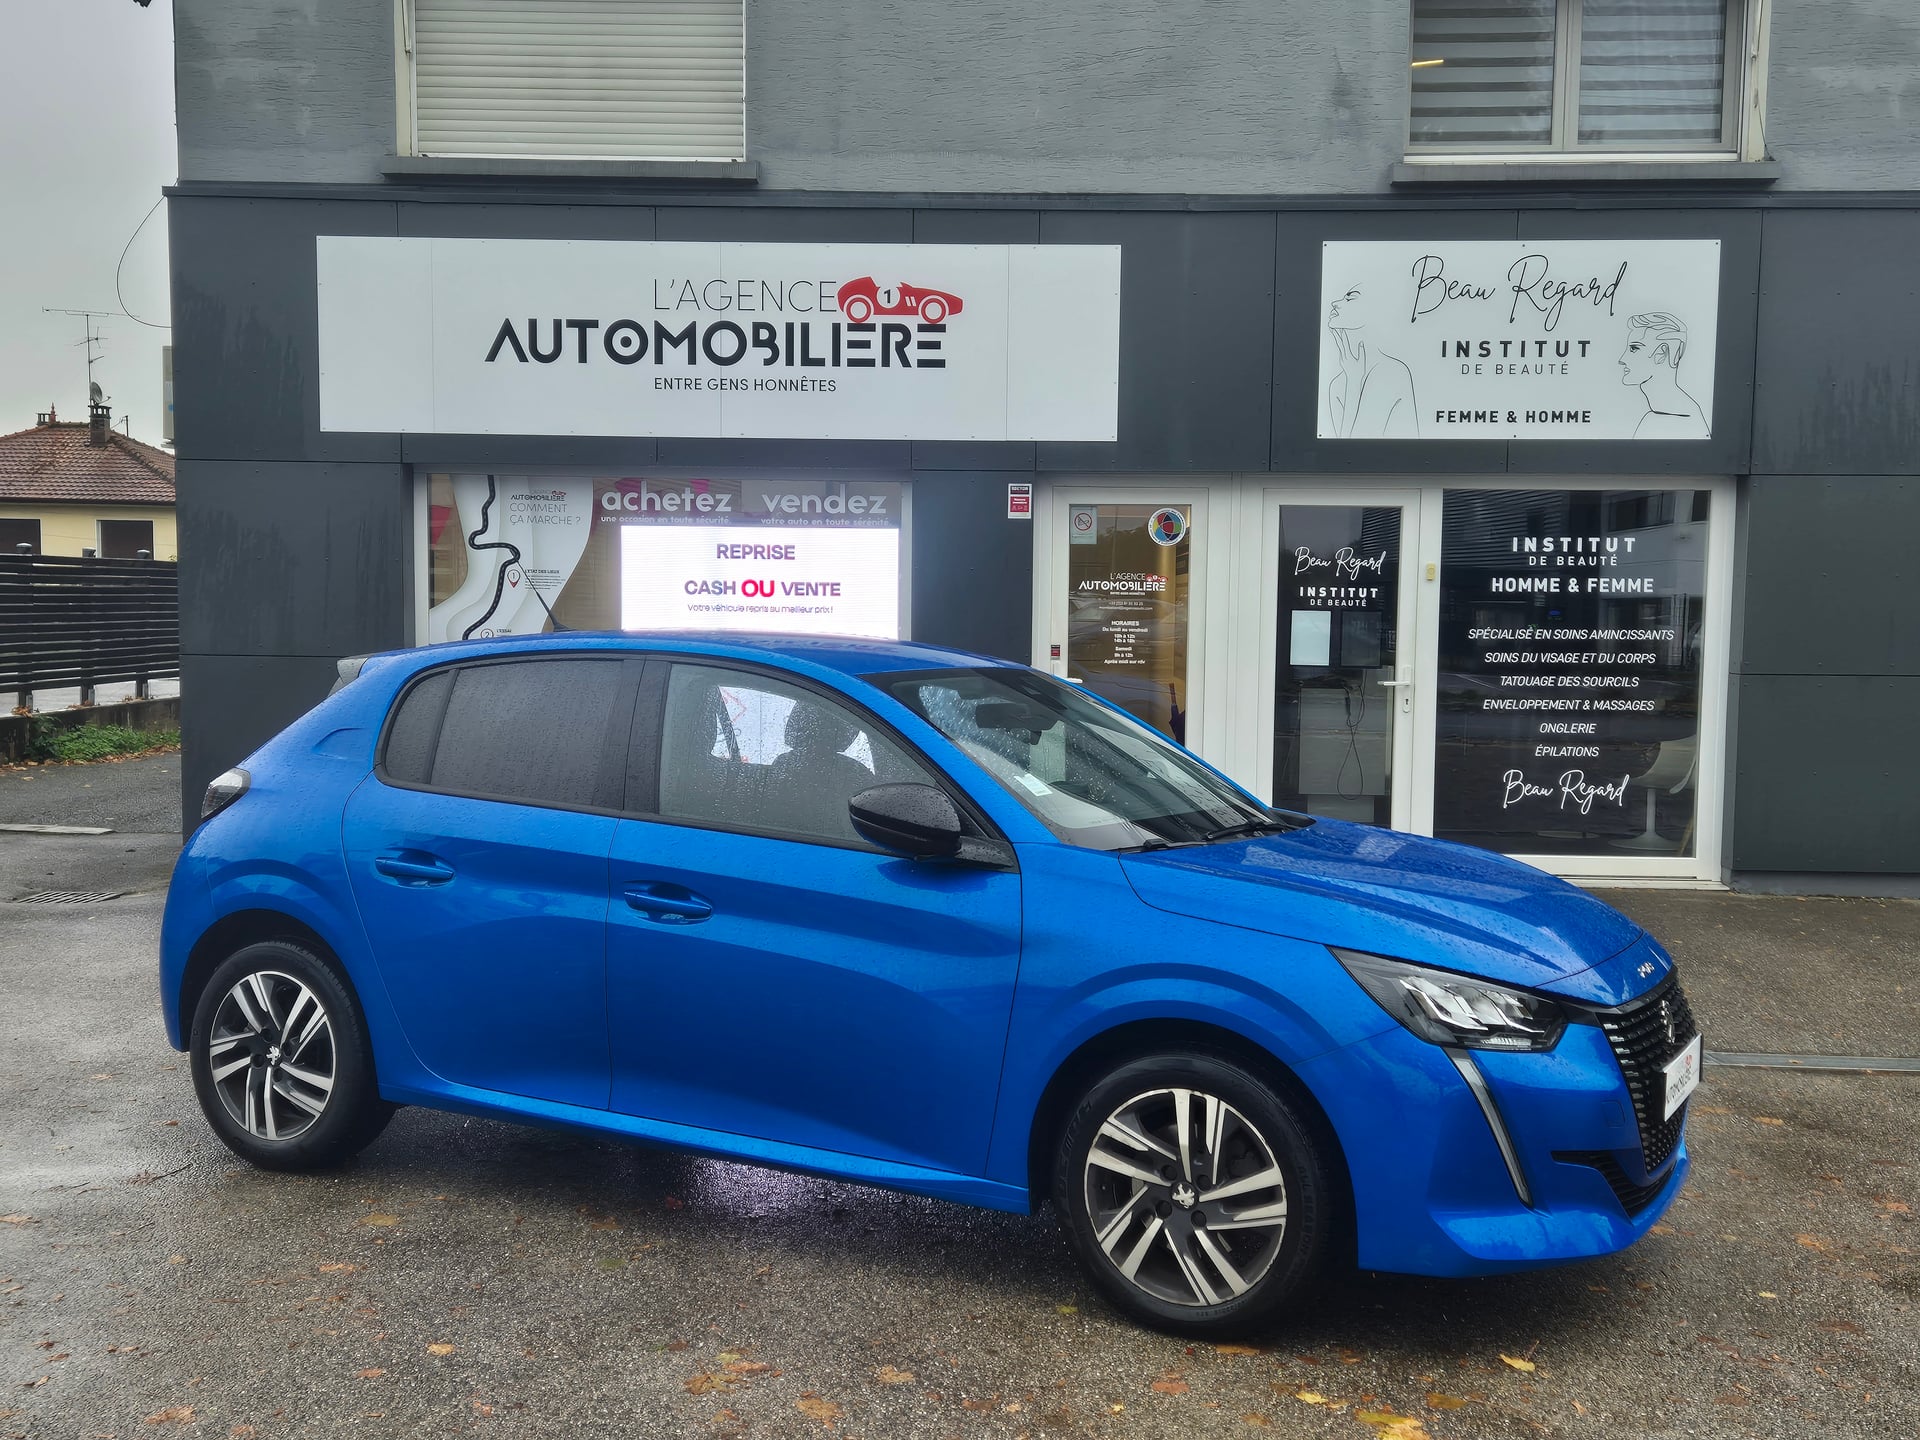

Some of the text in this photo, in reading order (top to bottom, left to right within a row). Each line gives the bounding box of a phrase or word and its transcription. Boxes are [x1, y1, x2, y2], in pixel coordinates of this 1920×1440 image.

[653, 279, 837, 312] L'AGENCE
[1411, 254, 1628, 332] Beau Regard
[1441, 340, 1593, 358] INSTITUT
[1461, 361, 1570, 376] DE BEAUTÉ
[654, 375, 837, 393] ENTRE GENS HONNÊTES
[1436, 411, 1593, 423] FEMME & HOMME
[601, 480, 732, 512] achetez
[762, 483, 887, 514] vendez
[509, 503, 568, 513] COMMENT
[509, 514, 581, 526] ÇA MARCHE ?
[618, 514, 656, 523] occasion
[670, 515, 694, 524] toute
[760, 518, 785, 526] votre
[787, 518, 809, 526] auto
[811, 518, 823, 526] en
[825, 518, 850, 526] toute
[1512, 537, 1636, 552] INSTITUT
[716, 544, 796, 560] REPRISE
[1294, 546, 1387, 581] Beau Regard
[1528, 554, 1618, 567] DE BEAUTÉ
[684, 579, 841, 597] CASH OU VENTE
[1300, 586, 1379, 598] INSTITUT
[1491, 578, 1655, 593] HOMME & FEMME
[687, 604, 711, 613] Votre
[711, 604, 745, 613] véhicule
[745, 605, 769, 615] repris
[781, 605, 813, 614] meilleur
[1328, 598, 1368, 607] BEAUTÉ
[1468, 626, 1675, 641] SPÉCIALISÉ EN SOINS AMINCISSANTS
[1484, 652, 1657, 664] SOINS DU VISAGE ET DU CORPS
[1500, 675, 1641, 688] TATOUAGE DES SOURCILS
[1482, 699, 1656, 712] ENVELOPPEMENT & MASSAGES
[1539, 723, 1598, 735] ONGLERIE
[1534, 744, 1601, 758] ÉPILATIONS
[1502, 769, 1631, 815] Beau Regard
